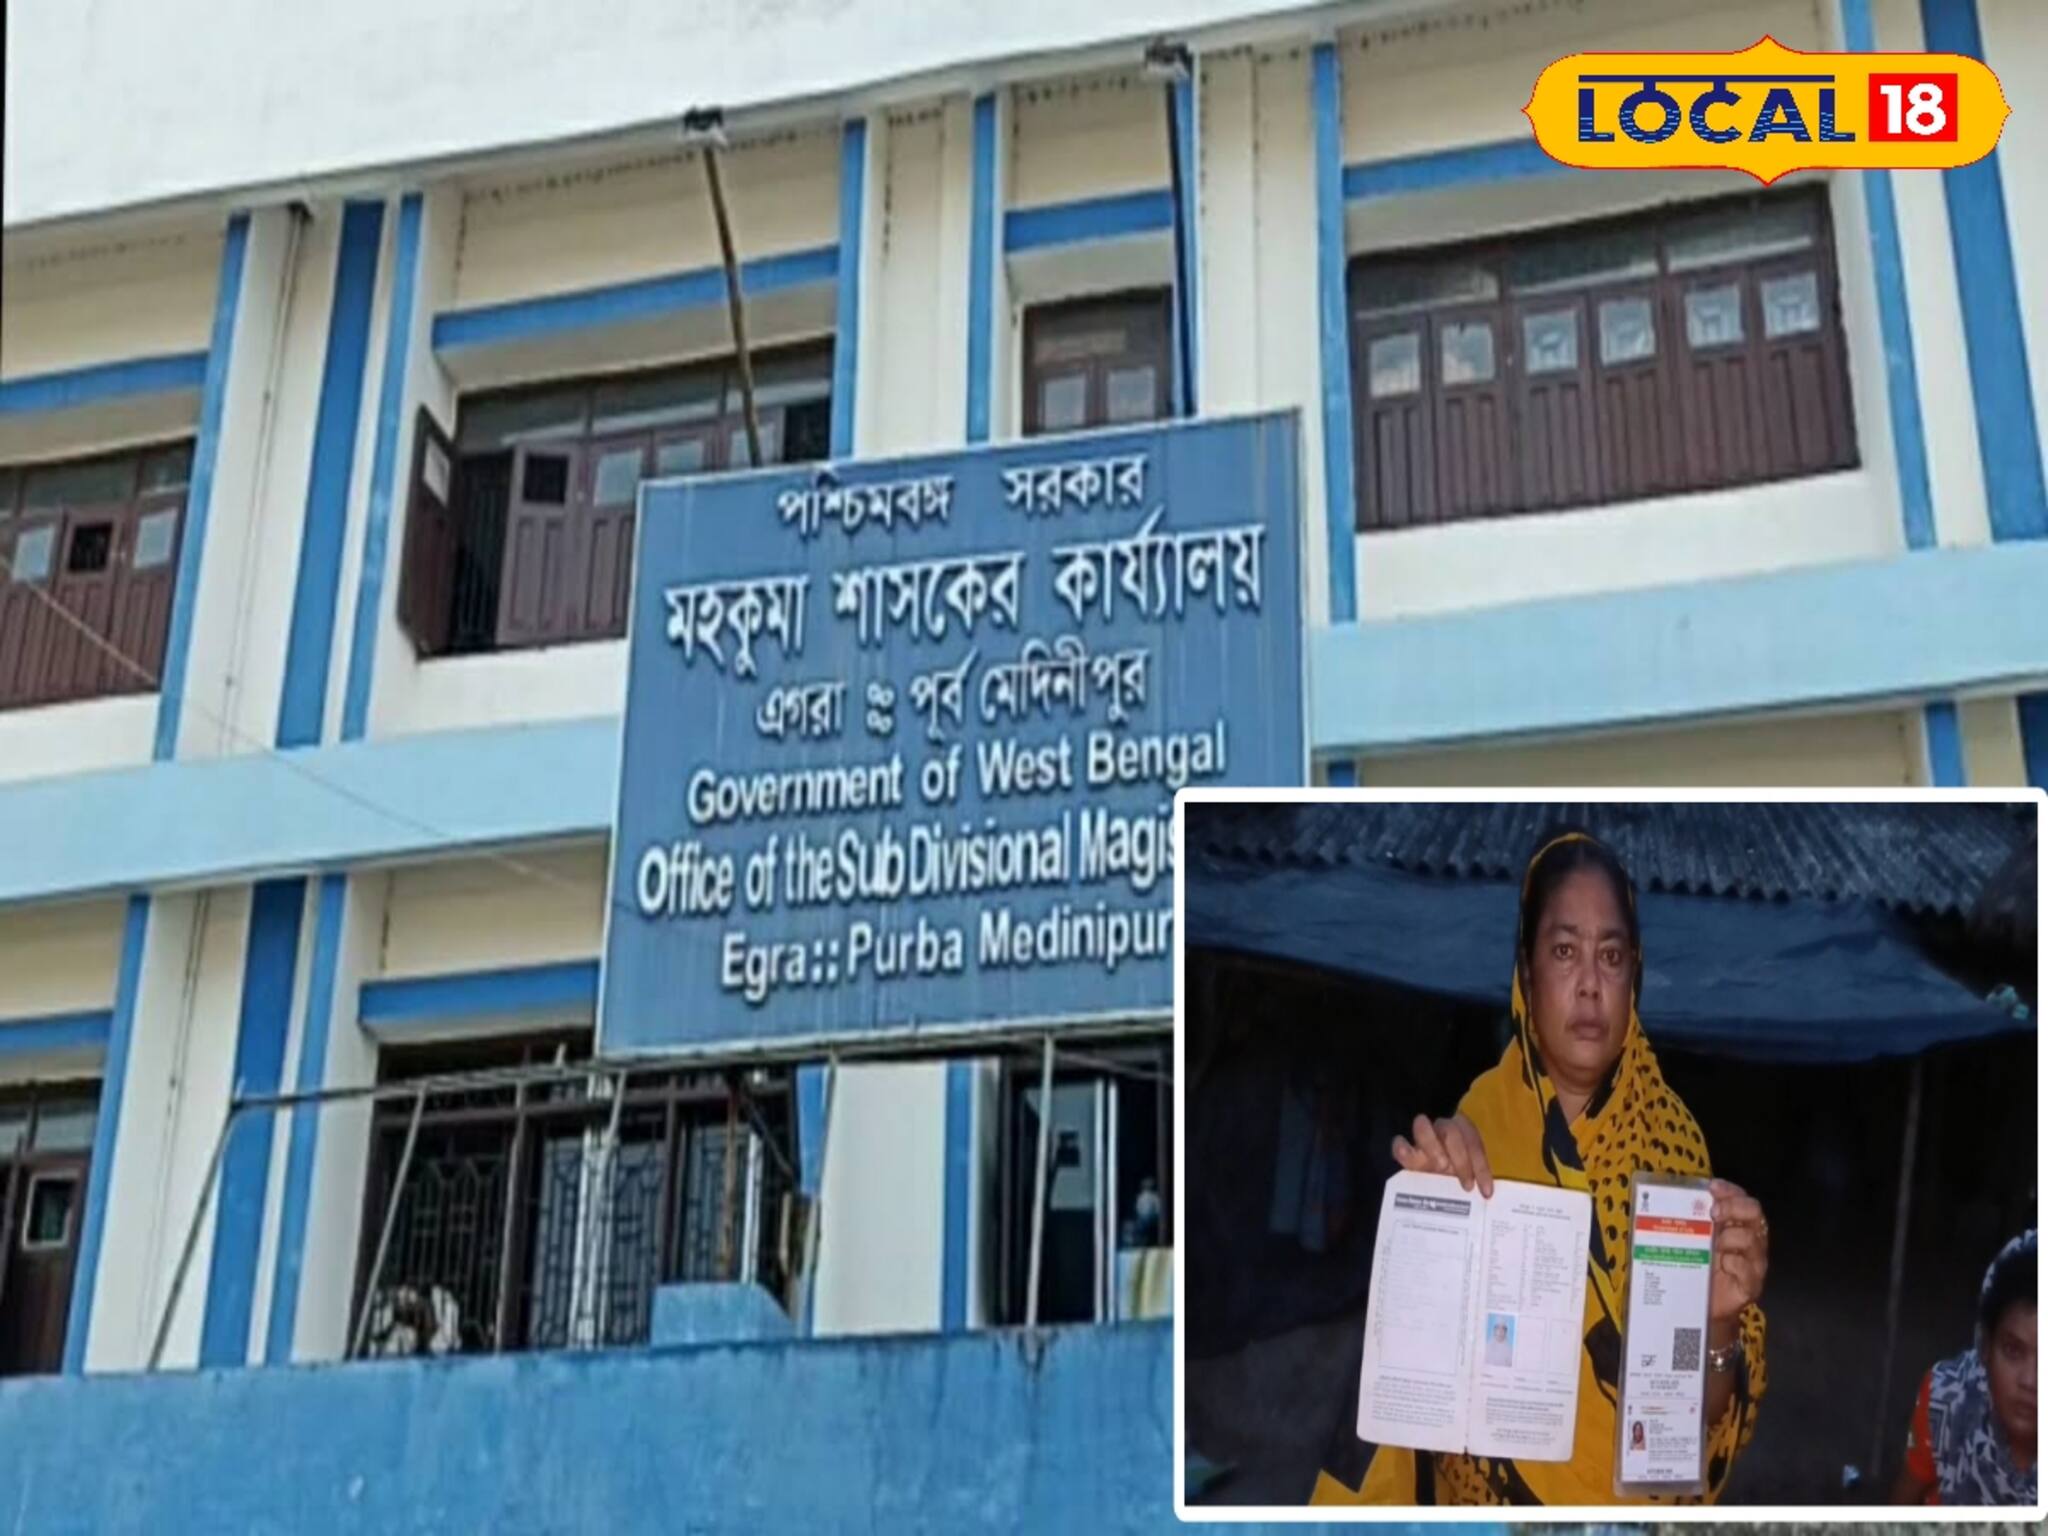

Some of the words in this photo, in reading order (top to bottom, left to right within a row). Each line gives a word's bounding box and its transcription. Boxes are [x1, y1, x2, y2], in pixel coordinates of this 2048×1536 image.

[777, 465, 954, 538] পশ্চিমবঙ্গ
[1003, 453, 1147, 514] সরকার
[665, 577, 810, 674] মহকুমা
[833, 551, 1025, 643] শাসকের
[756, 681, 845, 737] এগরা
[910, 648, 979, 742] পূর্ব
[980, 634, 1149, 722] মেদিনীপুর
[687, 764, 903, 824] Government
[921, 746, 962, 800] of
[977, 742, 1072, 796] West
[1086, 720, 1226, 788] Bengal
[637, 840, 733, 918] Office
[745, 838, 778, 910] of
[848, 917, 963, 979] Purba
[979, 901, 1174, 969] Medinipur
